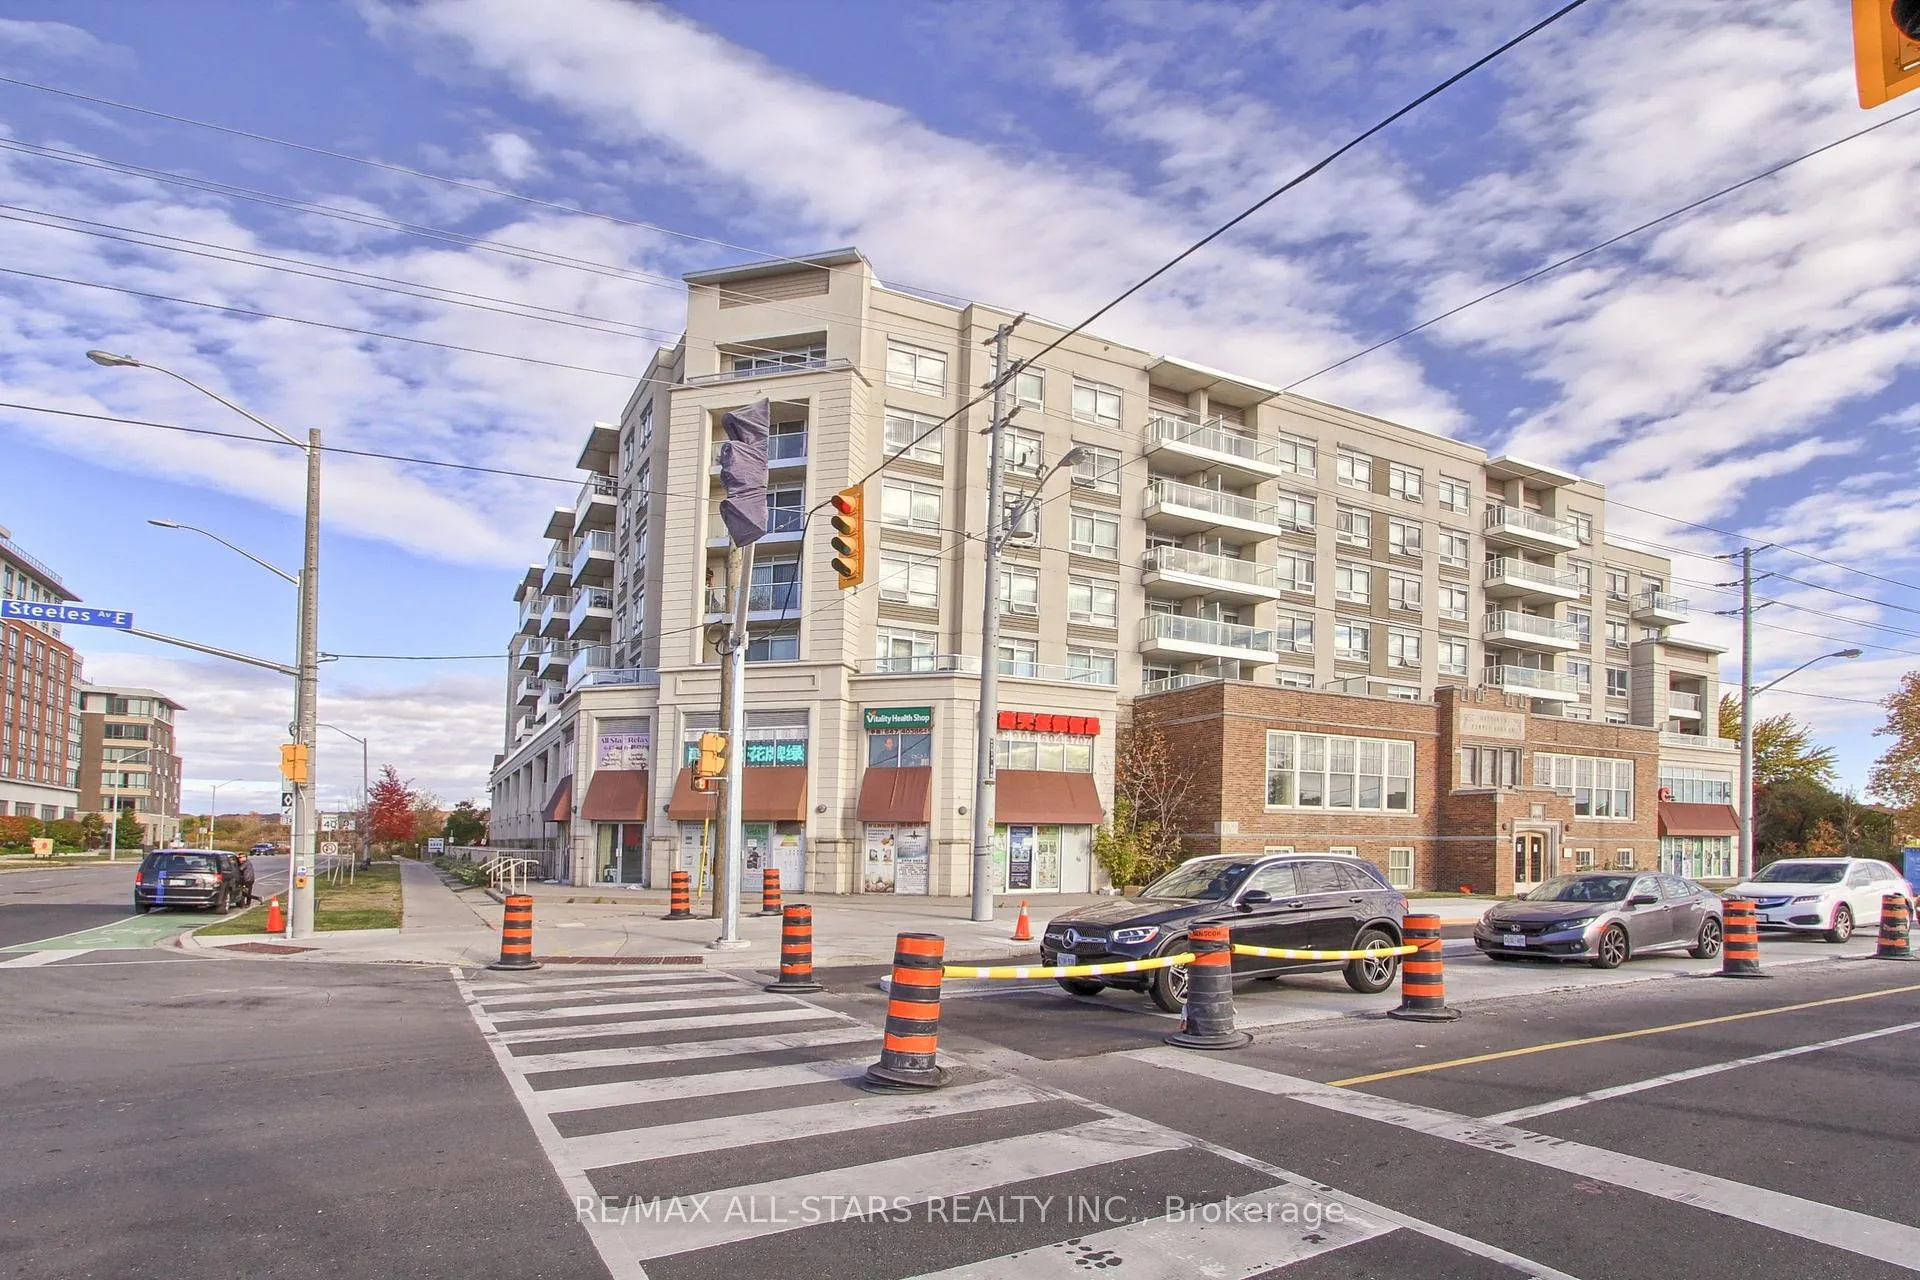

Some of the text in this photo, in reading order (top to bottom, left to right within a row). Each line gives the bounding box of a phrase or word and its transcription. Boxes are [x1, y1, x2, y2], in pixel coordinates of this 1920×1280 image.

[9, 601, 91, 621] Steeles
[116, 612, 126, 625] E
[866, 713, 930, 724] Vitality Health Shop
